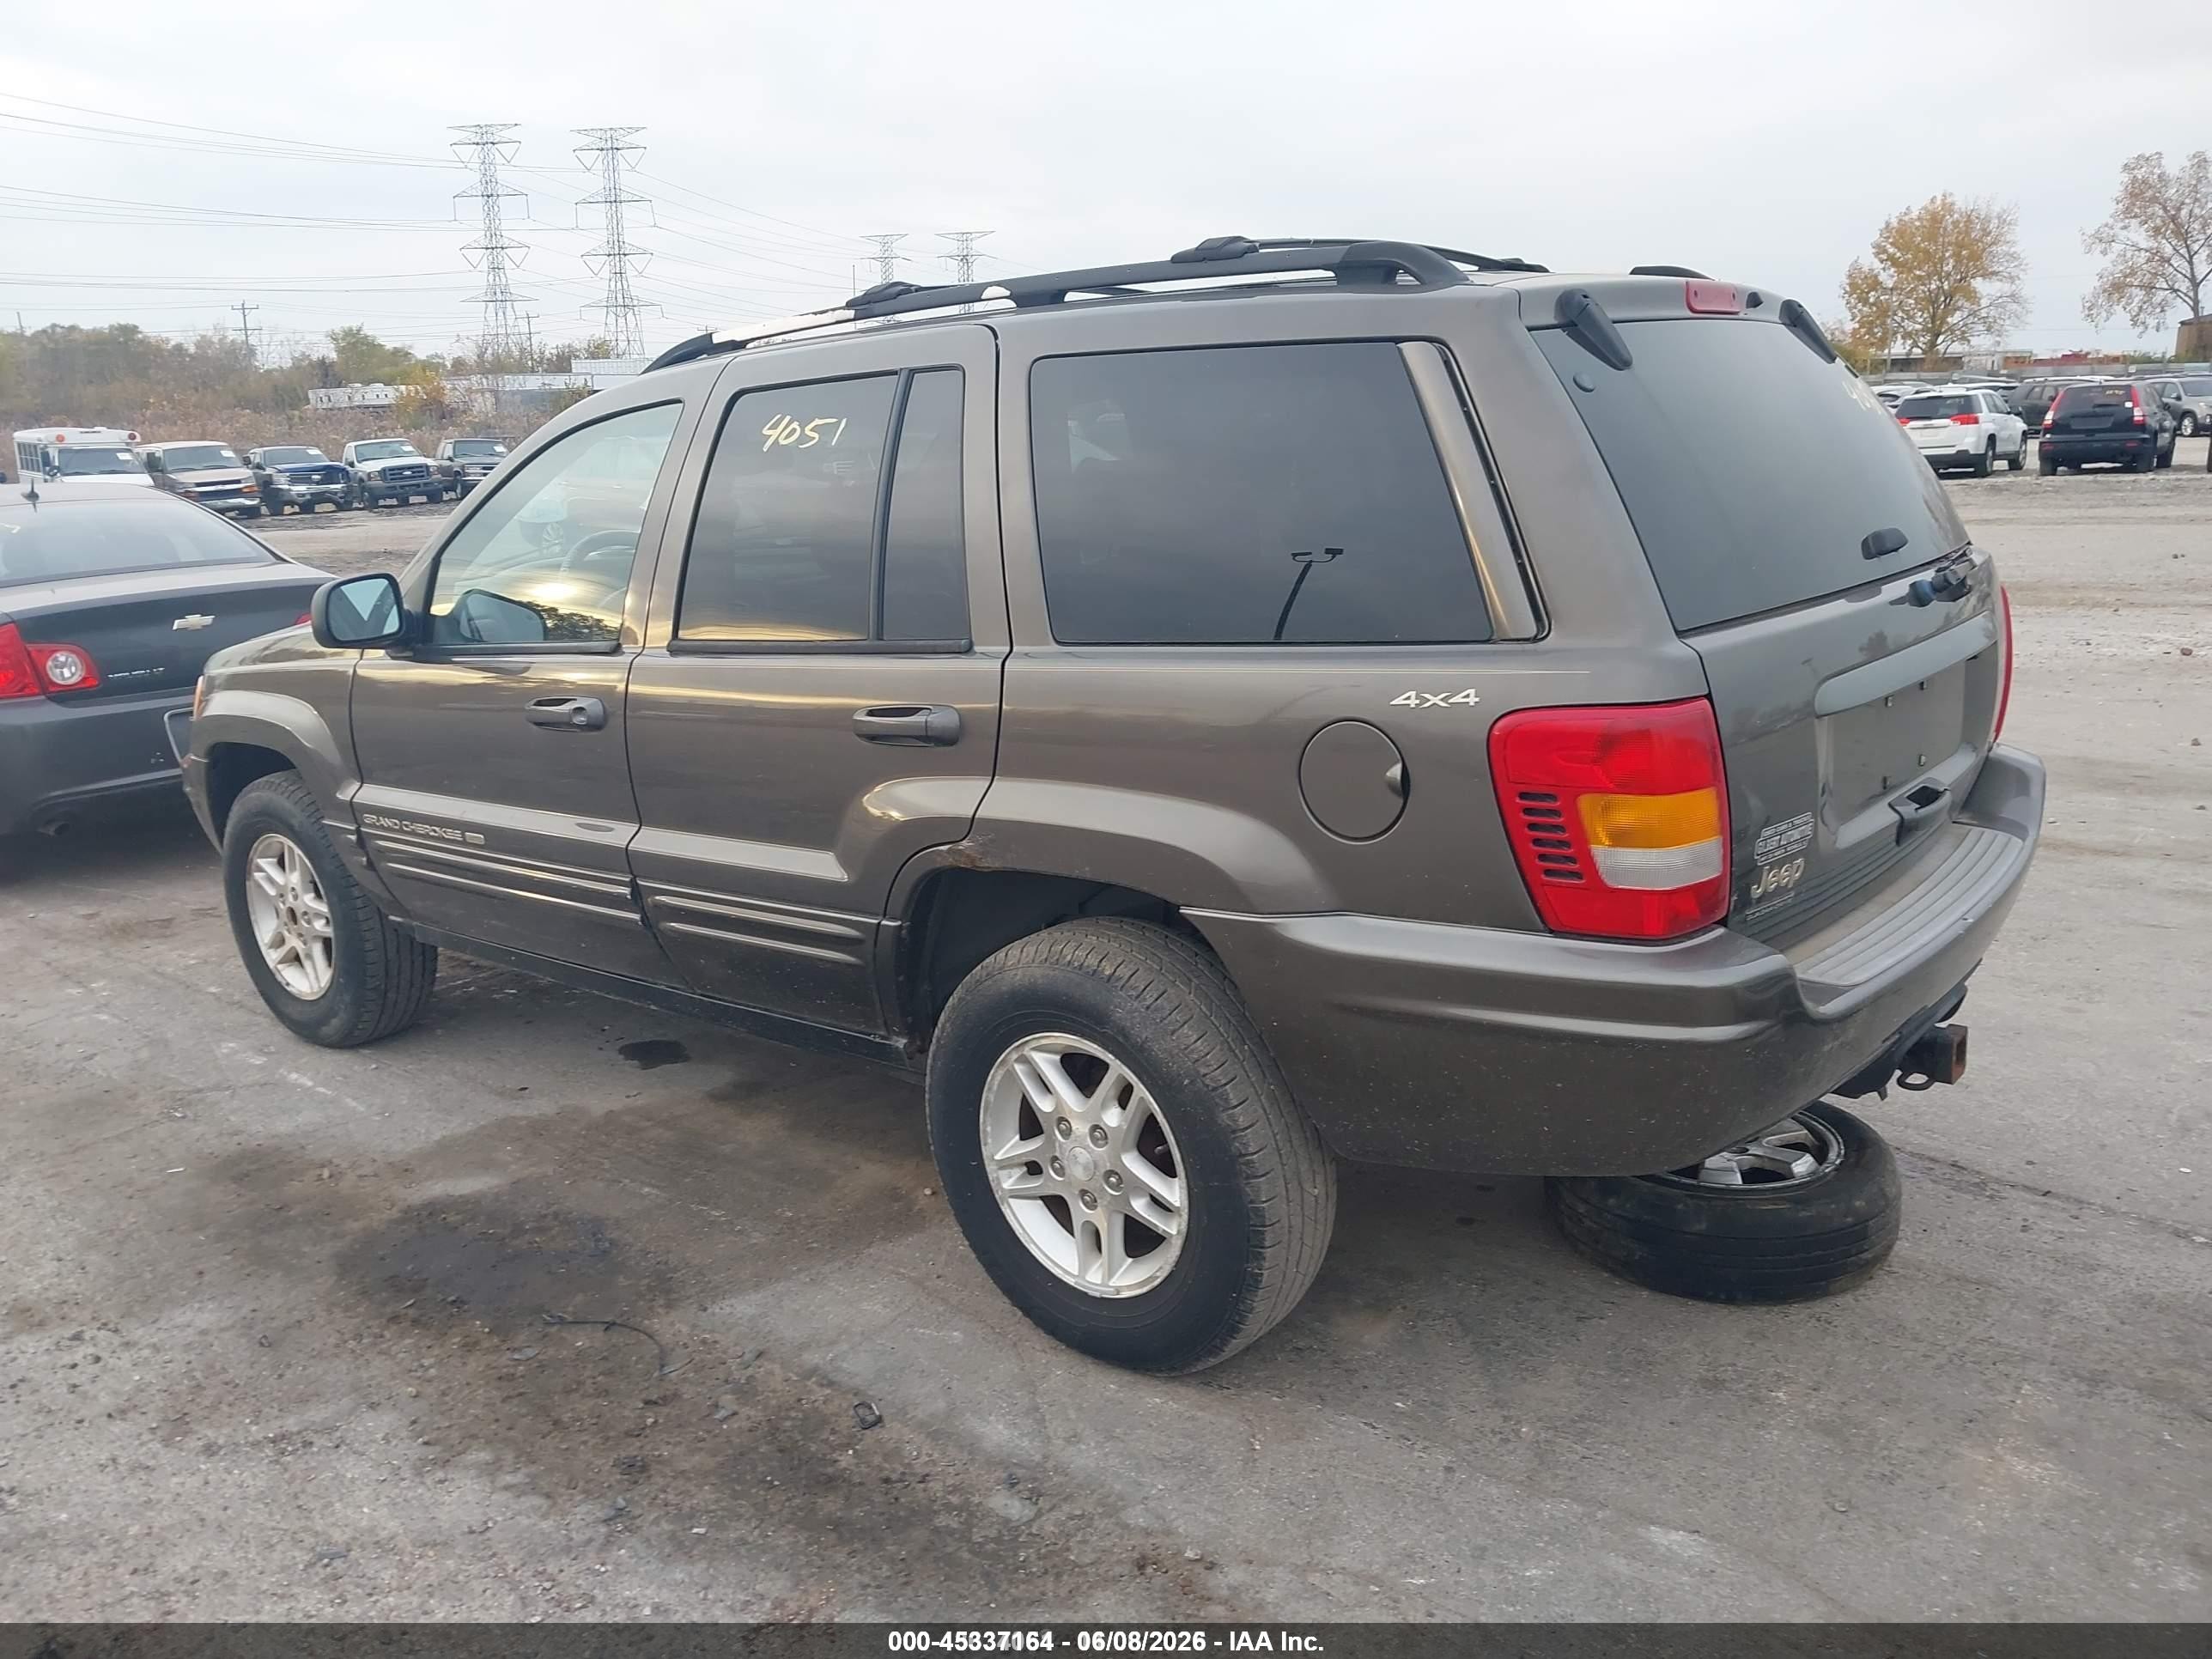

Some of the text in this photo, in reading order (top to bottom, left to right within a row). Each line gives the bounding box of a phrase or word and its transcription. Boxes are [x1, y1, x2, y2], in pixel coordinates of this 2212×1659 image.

[761, 413, 848, 453] 4051
[1389, 688, 1481, 709] 4x4
[362, 812, 400, 830] GRAND
[401, 820, 465, 842] CHEROKEE
[1750, 857, 1806, 899] Jeep
